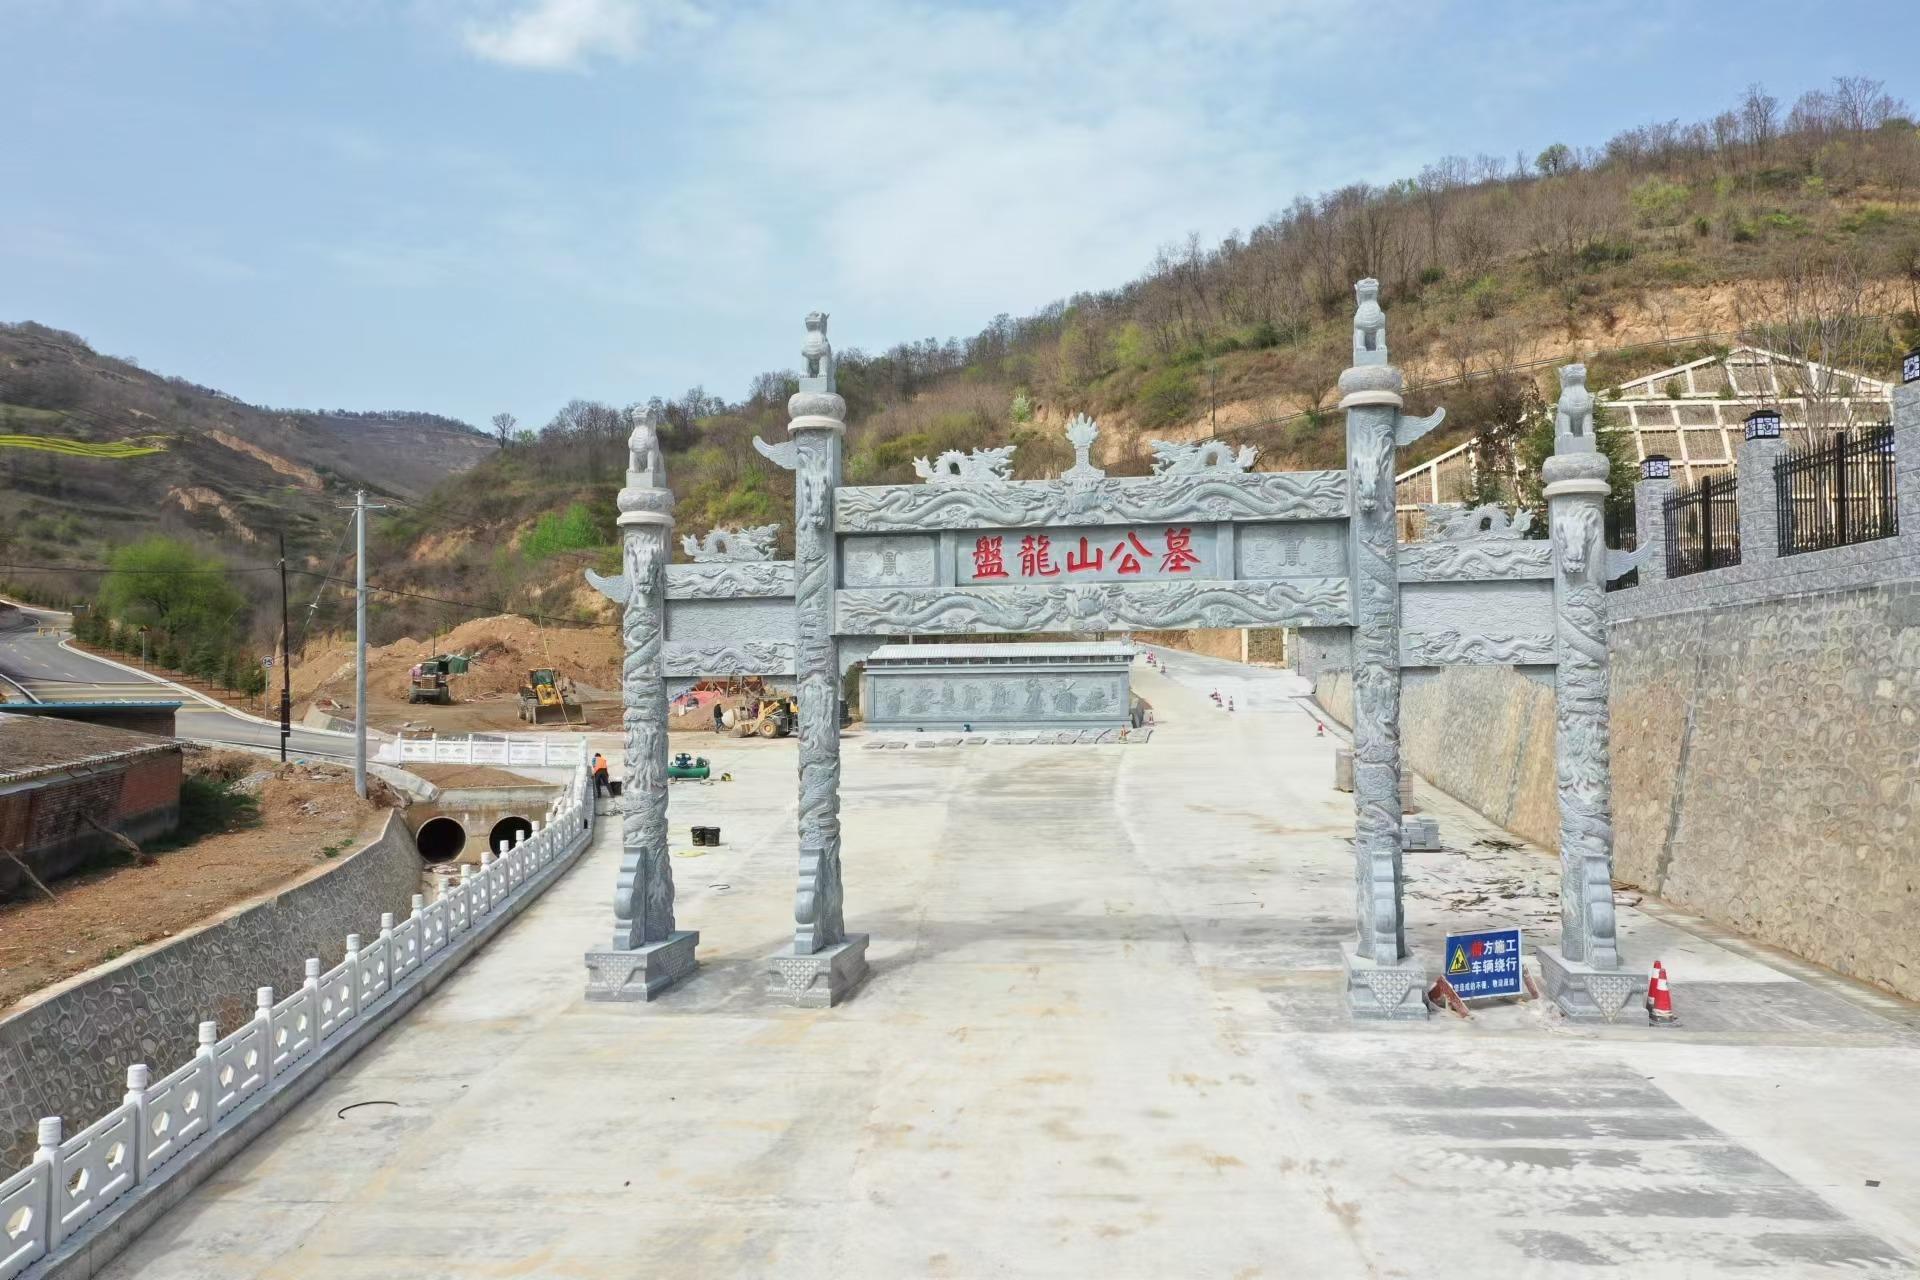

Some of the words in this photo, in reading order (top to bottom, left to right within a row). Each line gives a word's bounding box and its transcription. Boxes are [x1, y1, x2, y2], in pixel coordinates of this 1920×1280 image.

[972, 527, 1201, 578] 盤龍山公墓
[1471, 957, 1517, 974] 车辆绕行
